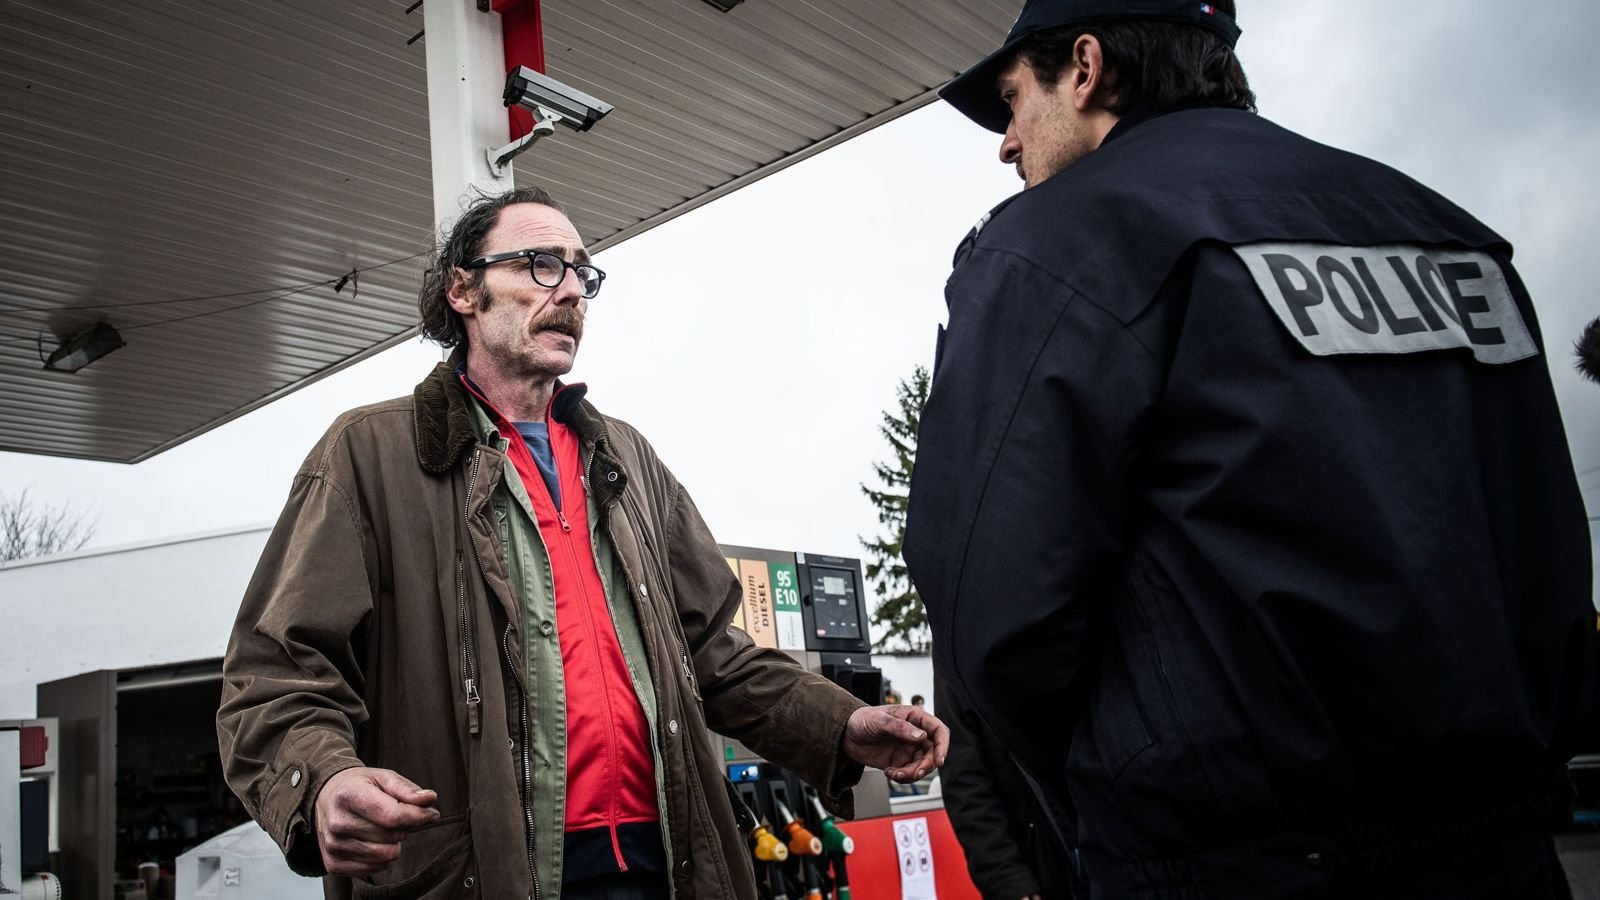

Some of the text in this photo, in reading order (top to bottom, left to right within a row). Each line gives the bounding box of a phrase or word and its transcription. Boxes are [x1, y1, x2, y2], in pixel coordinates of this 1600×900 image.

[1261, 253, 1506, 346] POLICE
[775, 588, 797, 606] E10
[776, 570, 791, 587] 95
[748, 575, 760, 633] excellium
[758, 583, 769, 627] DIESEL
